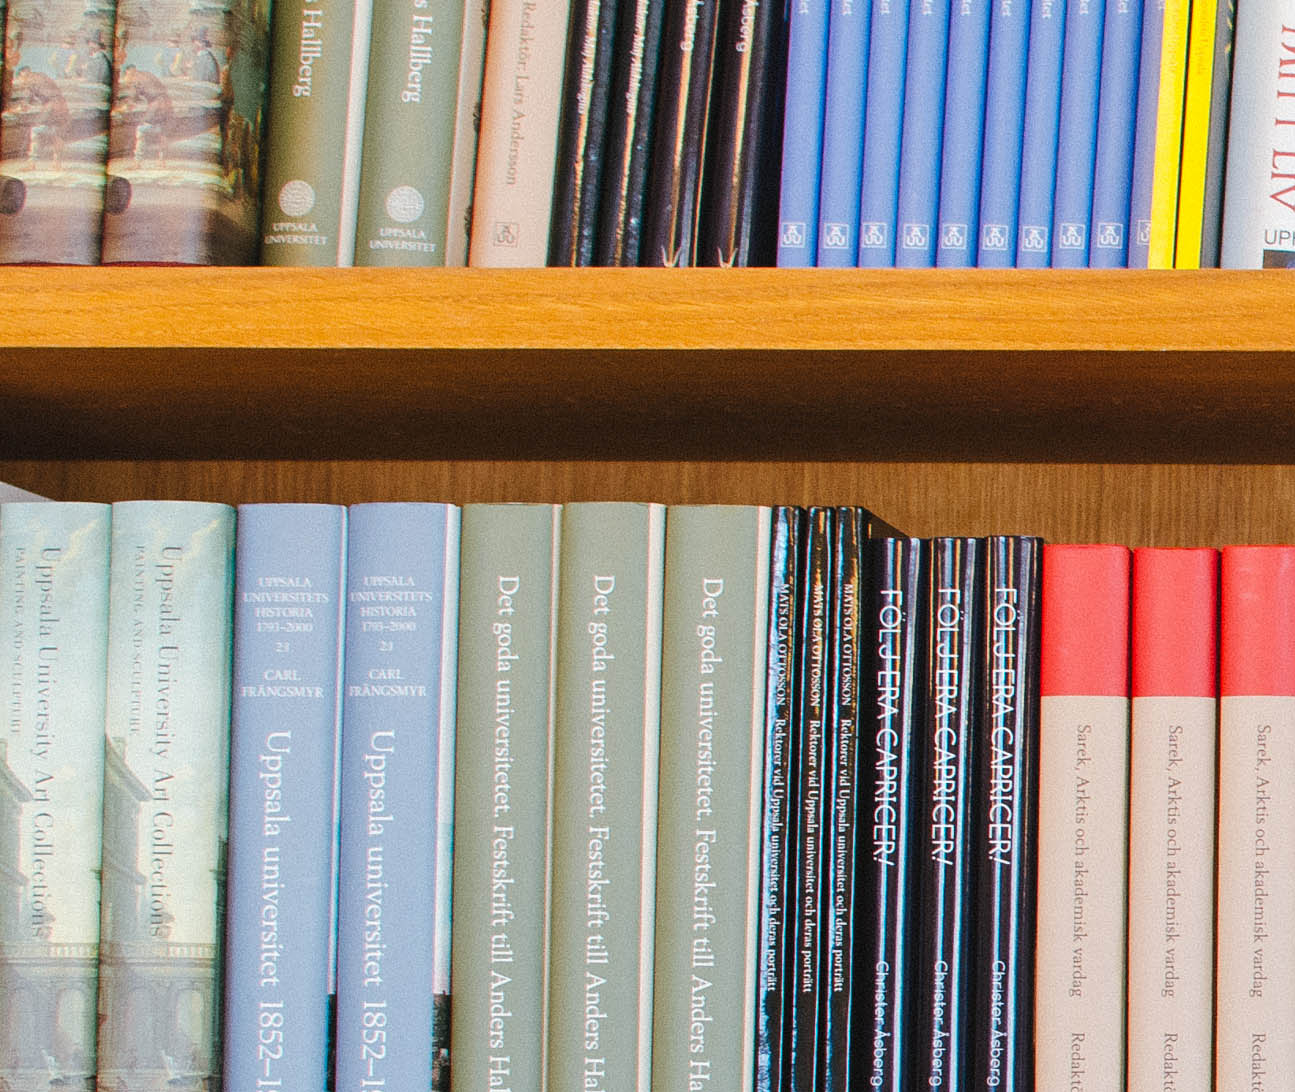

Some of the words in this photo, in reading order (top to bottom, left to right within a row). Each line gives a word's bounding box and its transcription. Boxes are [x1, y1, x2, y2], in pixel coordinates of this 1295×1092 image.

[401, 15, 434, 103] Hallberg
[514, 76, 529, 104] Lars
[506, 109, 527, 185] Andersson
[154, 546, 184, 636] Uppsala
[497, 575, 520, 615] Det
[492, 623, 519, 672] goda
[992, 587, 1021, 659] FÖLJ
[150, 644, 182, 759] University
[990, 669, 1015, 717] ERA
[493, 679, 515, 818] universitetet.
[807, 720, 821, 766] Rektorer
[1253, 724, 1272, 771] Sarek,
[152, 768, 178, 803] Art
[362, 730, 397, 836] Uppsala
[806, 767, 820, 785] vid
[988, 726, 1014, 864] CAPRICER!
[1254, 776, 1270, 824] Arktis
[803, 788, 819, 832] Uppsala
[805, 835, 818, 891] universitet
[1254, 828, 1270, 856] och
[148, 812, 175, 938] Collections
[491, 825, 514, 927] Festskrift
[360, 845, 391, 988] universitet
[804, 895, 817, 915] och
[1253, 860, 1269, 943] akademisk
[490, 934, 513, 963] till
[803, 918, 816, 946] deras
[801, 950, 815, 993] porträtt
[989, 960, 1006, 1025] Christer
[1249, 949, 1267, 997] vardag
[490, 970, 512, 1049] Anders
[987, 1030, 1006, 1086] Åsberg
